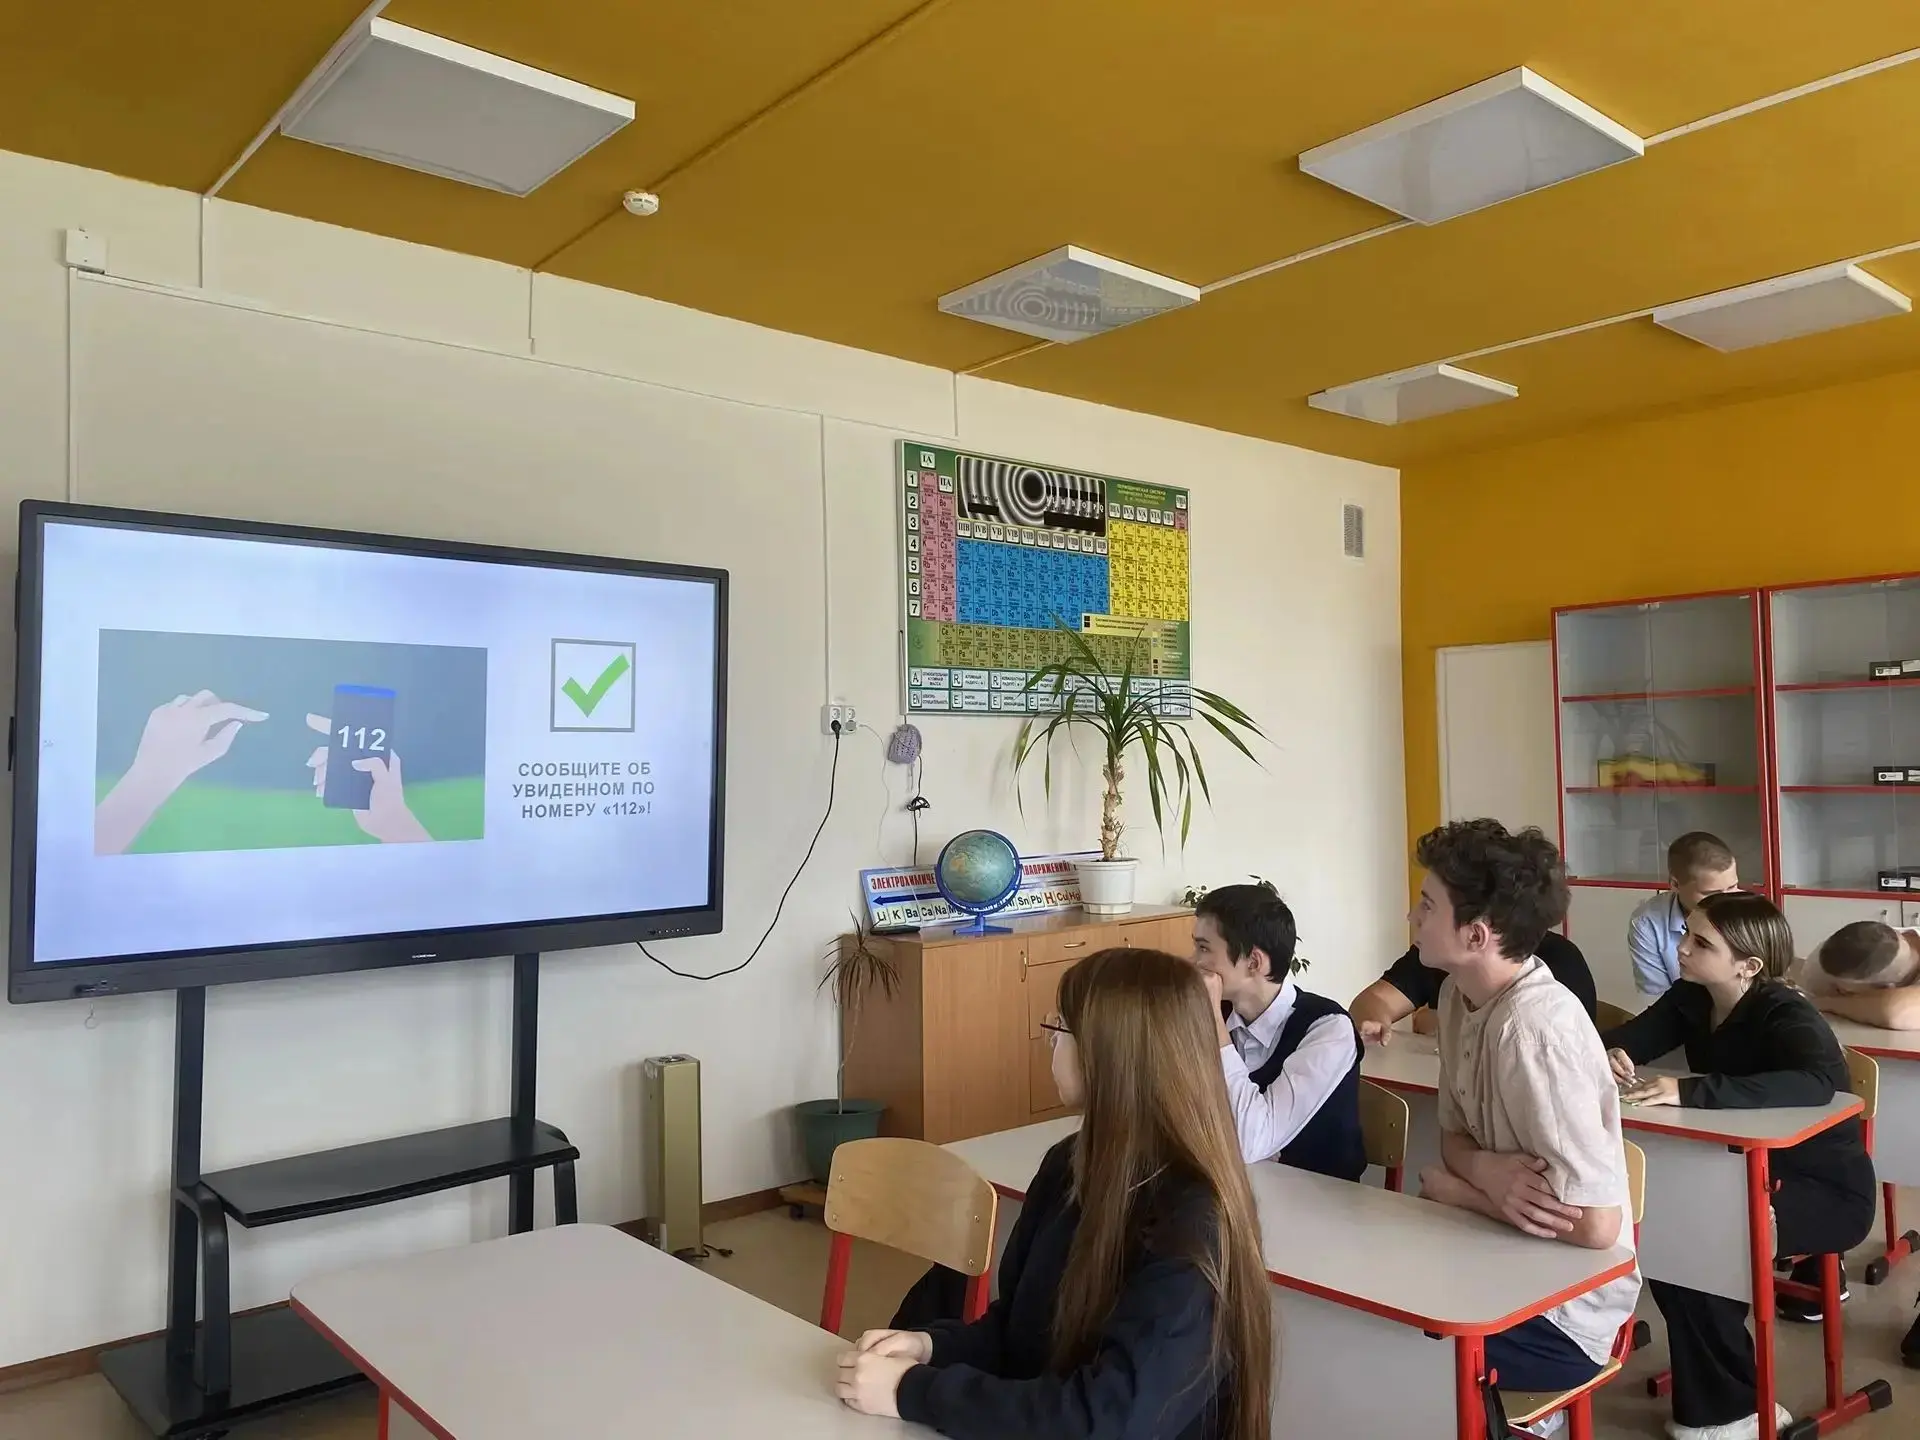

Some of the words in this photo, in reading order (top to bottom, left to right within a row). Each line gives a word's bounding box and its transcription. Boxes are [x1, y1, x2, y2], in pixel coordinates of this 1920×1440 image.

[910, 475, 914, 485] 1
[941, 478, 951, 487] IIA
[910, 496, 916, 506] 2
[910, 518, 916, 528] 3
[958, 522, 970, 531] IIIB
[975, 523, 987, 532] IVB
[992, 526, 1002, 535] VB
[910, 540, 916, 549] 4
[911, 561, 917, 571] 5
[911, 582, 917, 592] 6
[911, 604, 918, 613] 7
[338, 725, 386, 751] 112
[518, 762, 621, 778] СООБЩИТЕ
[628, 761, 651, 775] ОБ
[512, 781, 625, 799] УВИДЕННОМ
[632, 781, 655, 795] ПО
[522, 803, 596, 818] НОМЕРУ
[602, 801, 651, 815] «112»!
[871, 873, 936, 890] ЭЛЕКТРОХИМИЧЕ
[876, 911, 887, 922] Li
[893, 909, 901, 919] K
[906, 908, 919, 918] Ba
[922, 907, 933, 917] Ca
[934, 905, 947, 915] Na
[1017, 896, 1030, 906] Sn
[1030, 895, 1042, 904] Pb
[1044, 892, 1055, 904] H
[1056, 892, 1069, 901] Cu
